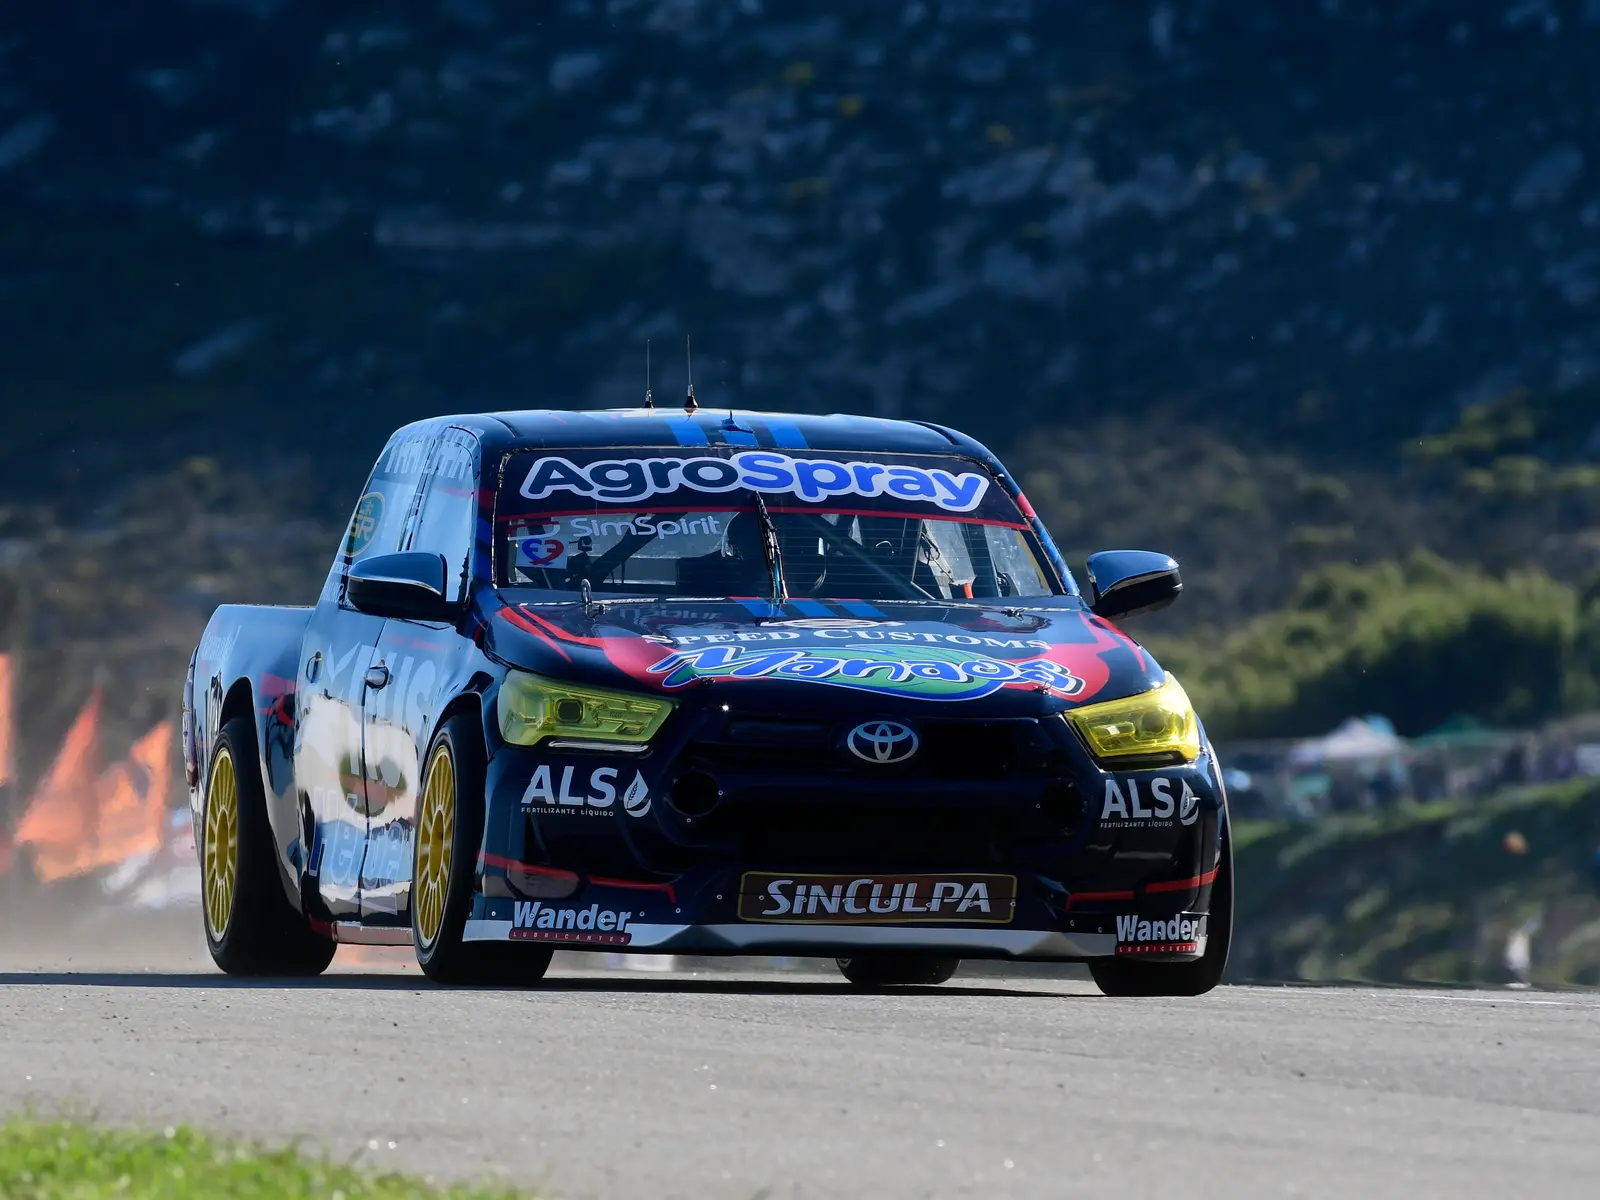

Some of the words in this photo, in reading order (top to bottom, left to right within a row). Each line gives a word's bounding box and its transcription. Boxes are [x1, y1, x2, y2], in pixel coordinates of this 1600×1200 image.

[519, 451, 990, 513] AgroSpray
[570, 515, 723, 540] SimSpirit
[641, 630, 801, 646] SPEED
[813, 629, 1053, 651] CUSTOMS
[646, 645, 1086, 695] Manaos
[520, 764, 619, 808] ALS
[1100, 777, 1175, 819] ALS
[520, 807, 576, 815] FERTILIZANTE
[580, 808, 615, 817] LÍQUIDO
[1147, 820, 1174, 828] LÍQUIDO
[513, 901, 632, 932] Wander
[1116, 913, 1199, 942] Wander
[513, 931, 626, 943] LUBRICANTES
